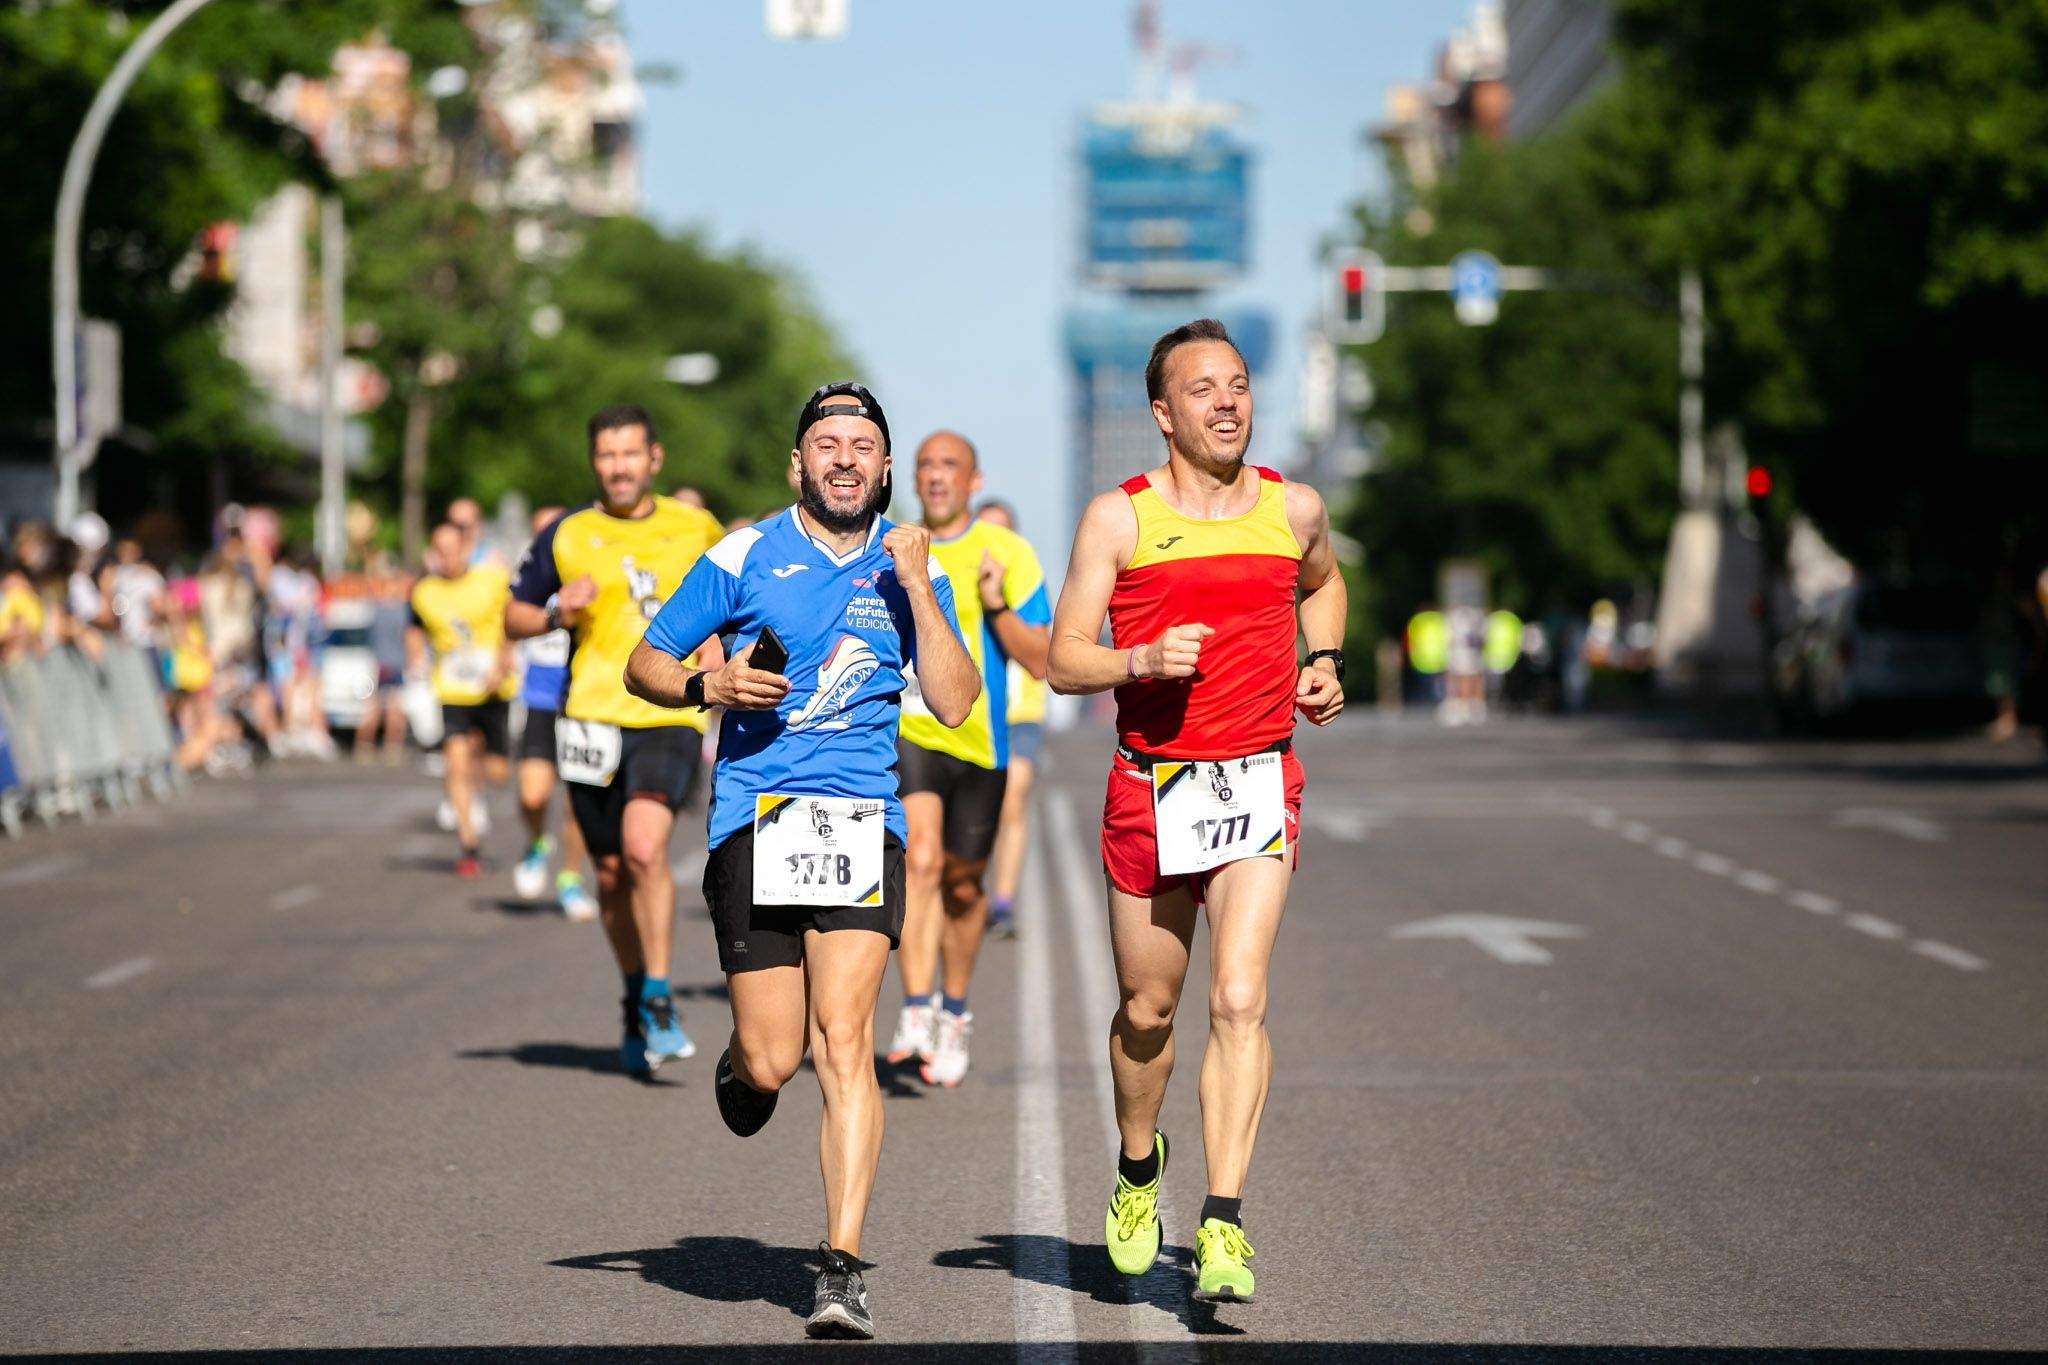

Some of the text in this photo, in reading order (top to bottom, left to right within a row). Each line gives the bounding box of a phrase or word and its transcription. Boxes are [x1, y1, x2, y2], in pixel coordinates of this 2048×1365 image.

[847, 605, 896, 620] ProFuturo
[846, 617, 895, 632] V EDICIÓN
[1220, 790, 1231, 800] 13
[1191, 812, 1251, 850] 1777
[785, 853, 851, 885] 1778
